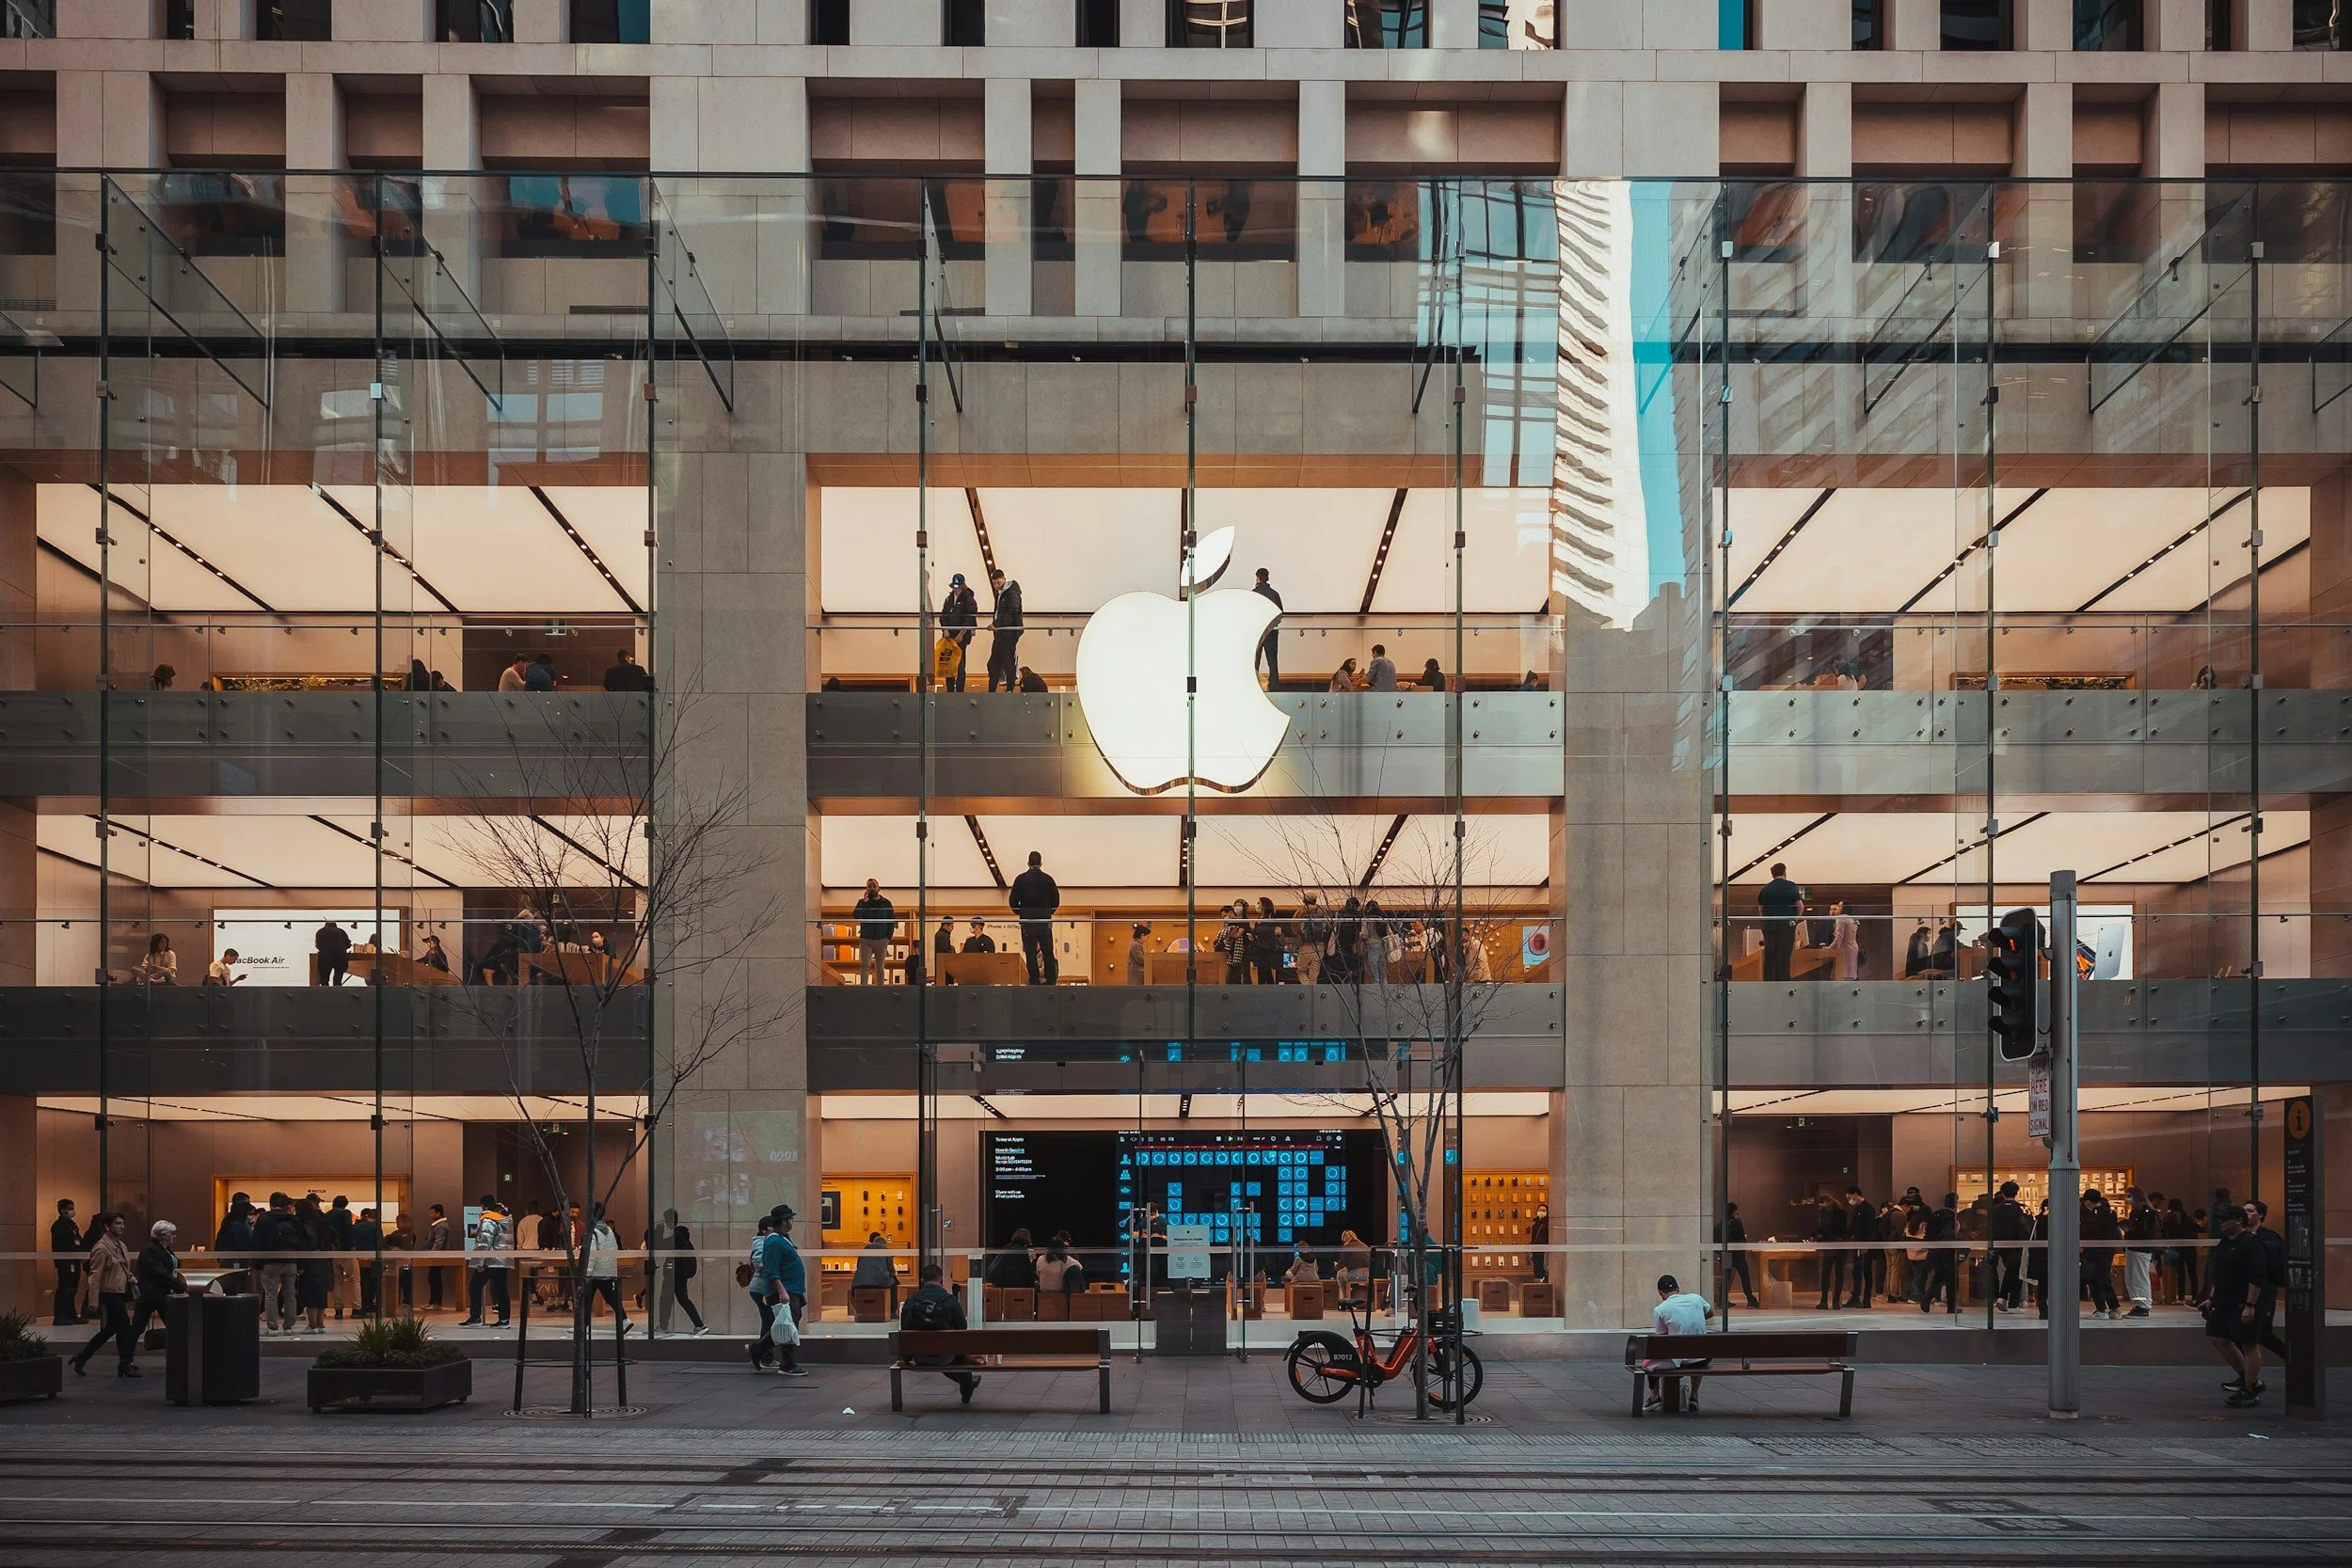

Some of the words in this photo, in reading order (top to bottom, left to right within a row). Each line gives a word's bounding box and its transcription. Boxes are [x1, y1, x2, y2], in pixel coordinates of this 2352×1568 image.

[2030, 1059, 2047, 1074] STOP
[2030, 1078, 2047, 1095] HERE
[2030, 1101, 2038, 1113] ON
[2038, 1099, 2049, 1112] RED
[2030, 1117, 2049, 1132] SIGNAL
